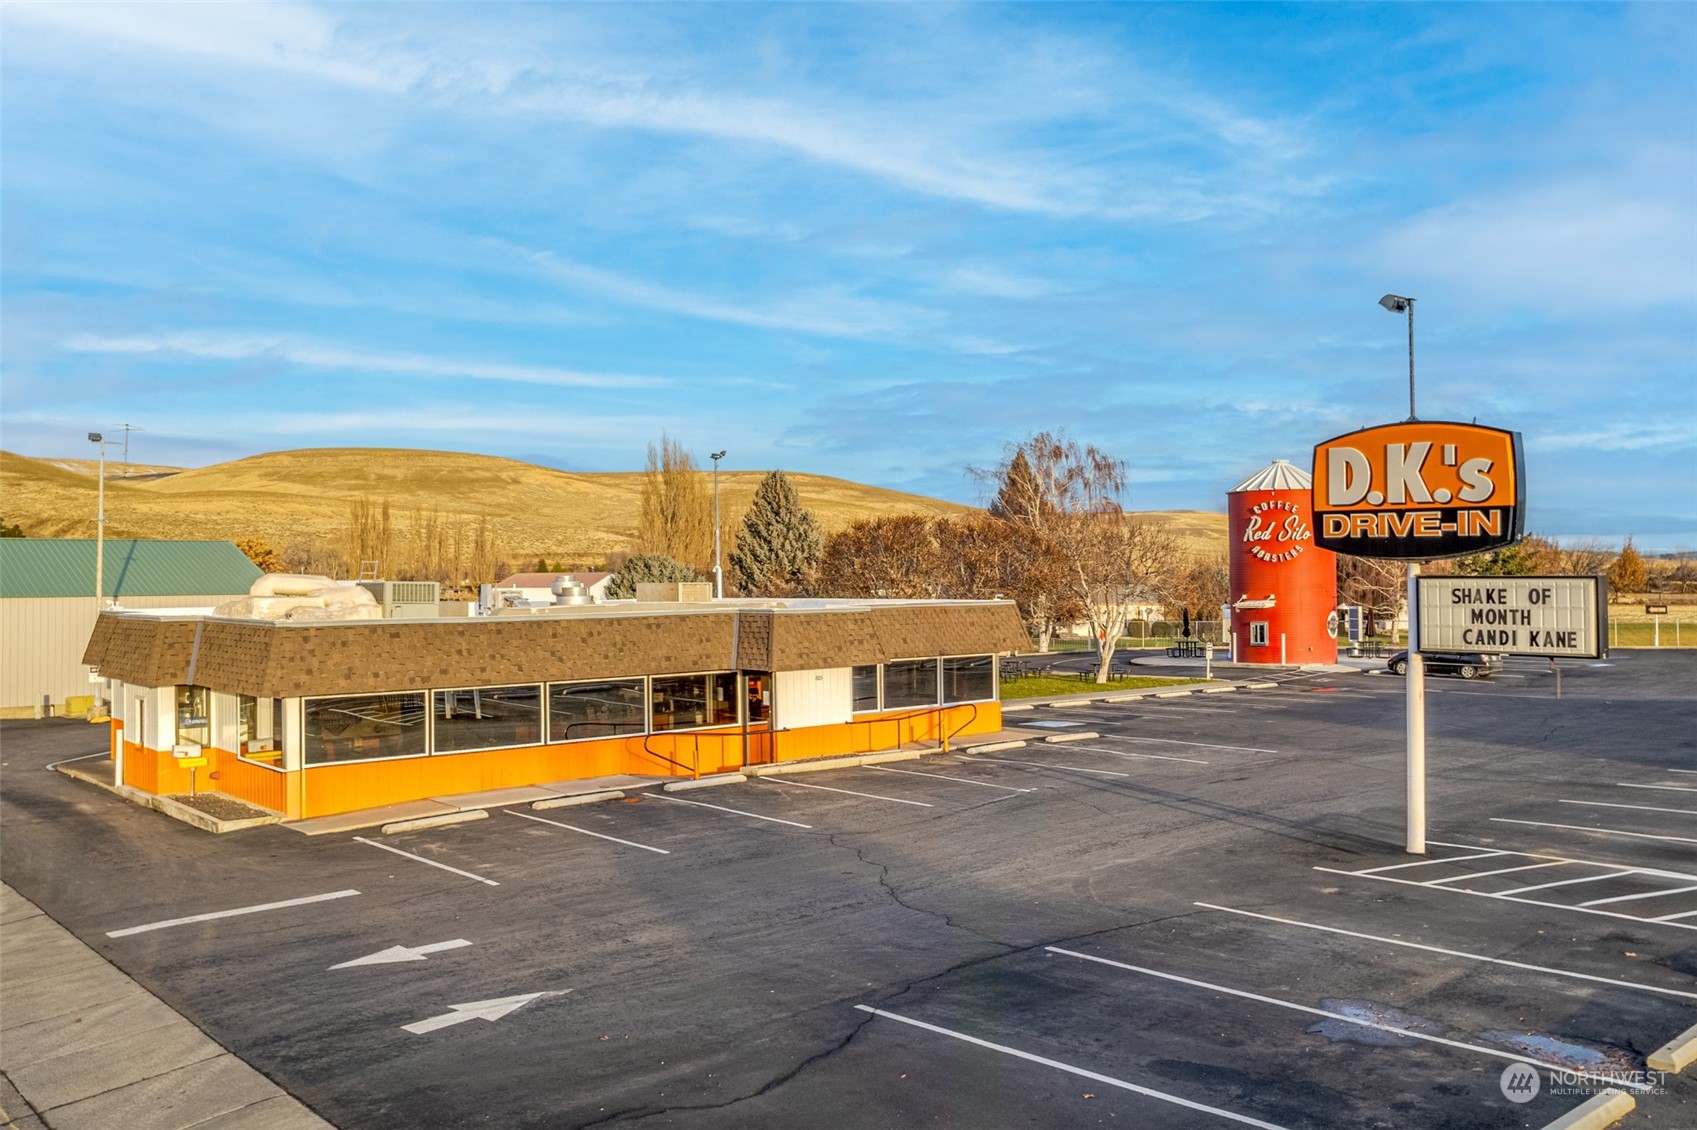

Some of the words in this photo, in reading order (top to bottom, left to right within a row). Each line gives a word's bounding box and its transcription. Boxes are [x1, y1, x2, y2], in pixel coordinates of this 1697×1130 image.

[1327, 441, 1495, 506] D.K.'s
[1252, 500, 1300, 514] COFFEE
[1243, 515, 1277, 542] Red
[1278, 515, 1312, 542] Silo
[1322, 509, 1501, 539] DRIVE-IN
[1251, 545, 1304, 563] ROASTERS
[1451, 588, 1507, 605] SHAKE
[1528, 588, 1551, 605] OF
[1471, 608, 1531, 626] MONTH
[1462, 629, 1517, 646] CANDI
[1529, 630, 1577, 648] KANE
